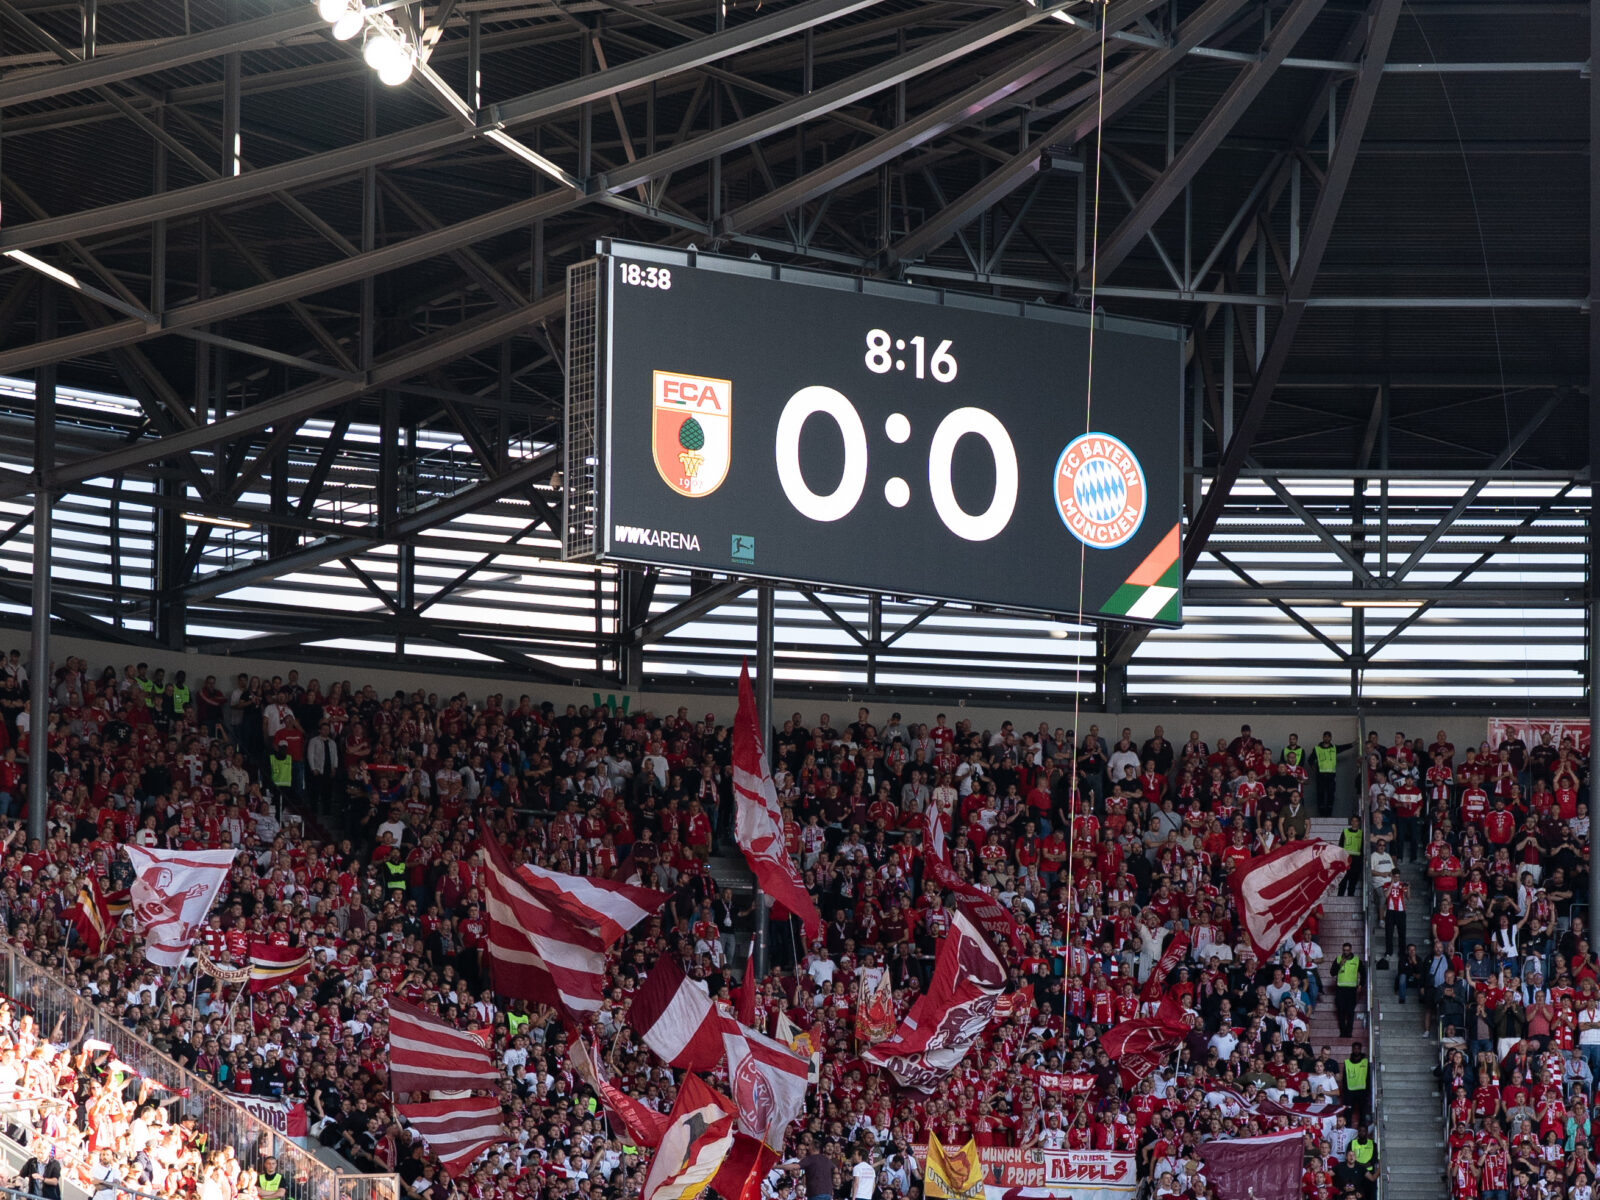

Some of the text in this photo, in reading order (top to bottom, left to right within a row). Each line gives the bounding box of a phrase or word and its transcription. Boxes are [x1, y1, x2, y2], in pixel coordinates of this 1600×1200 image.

[620, 263, 671, 290] 18:38
[865, 328, 958, 383] 8:16
[663, 380, 722, 411] FCA
[776, 386, 1018, 541] 0:0
[1062, 440, 1139, 487] FC BAYERN
[1062, 497, 1138, 541] MÜNCHEN
[1007, 1166, 1045, 1187] PRIDE
[1051, 1158, 1128, 1183] REBELS
